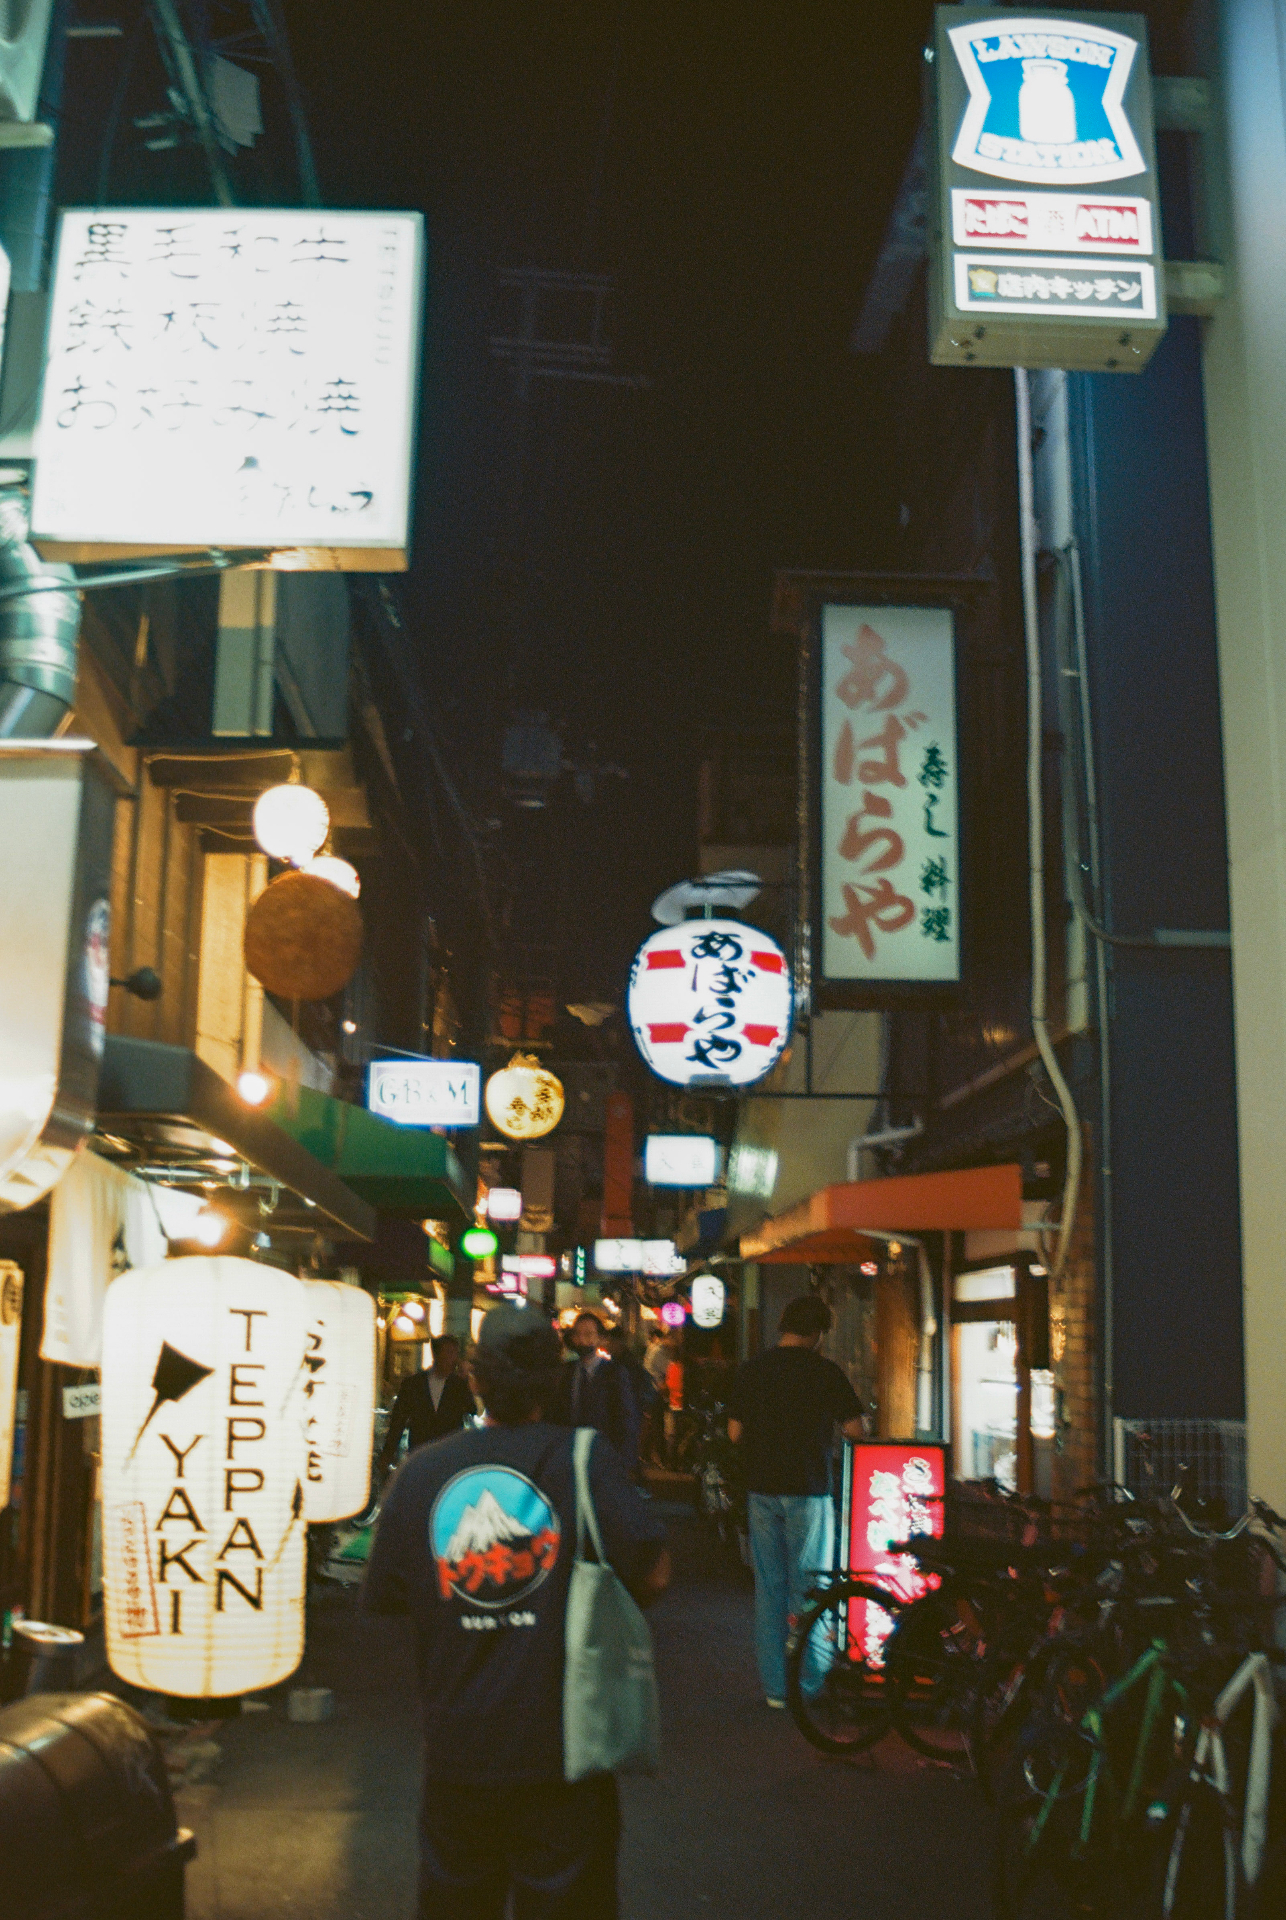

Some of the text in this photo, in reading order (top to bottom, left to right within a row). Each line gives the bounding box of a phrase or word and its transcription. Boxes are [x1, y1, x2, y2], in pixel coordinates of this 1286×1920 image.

[973, 34, 1116, 68] LAWSON
[978, 133, 1121, 167] STATION
[73, 222, 350, 284] 黒毛和牛
[1078, 207, 1139, 239] ATM
[998, 272, 1141, 301] 店内キッチン
[63, 298, 309, 355] 鉄板焼
[56, 375, 362, 438] お好み焼
[828, 623, 929, 961] あばらや
[685, 931, 756, 1069] あばらや
[215, 1308, 268, 1613] TEPPAN
[155, 1433, 206, 1635] YAKI
